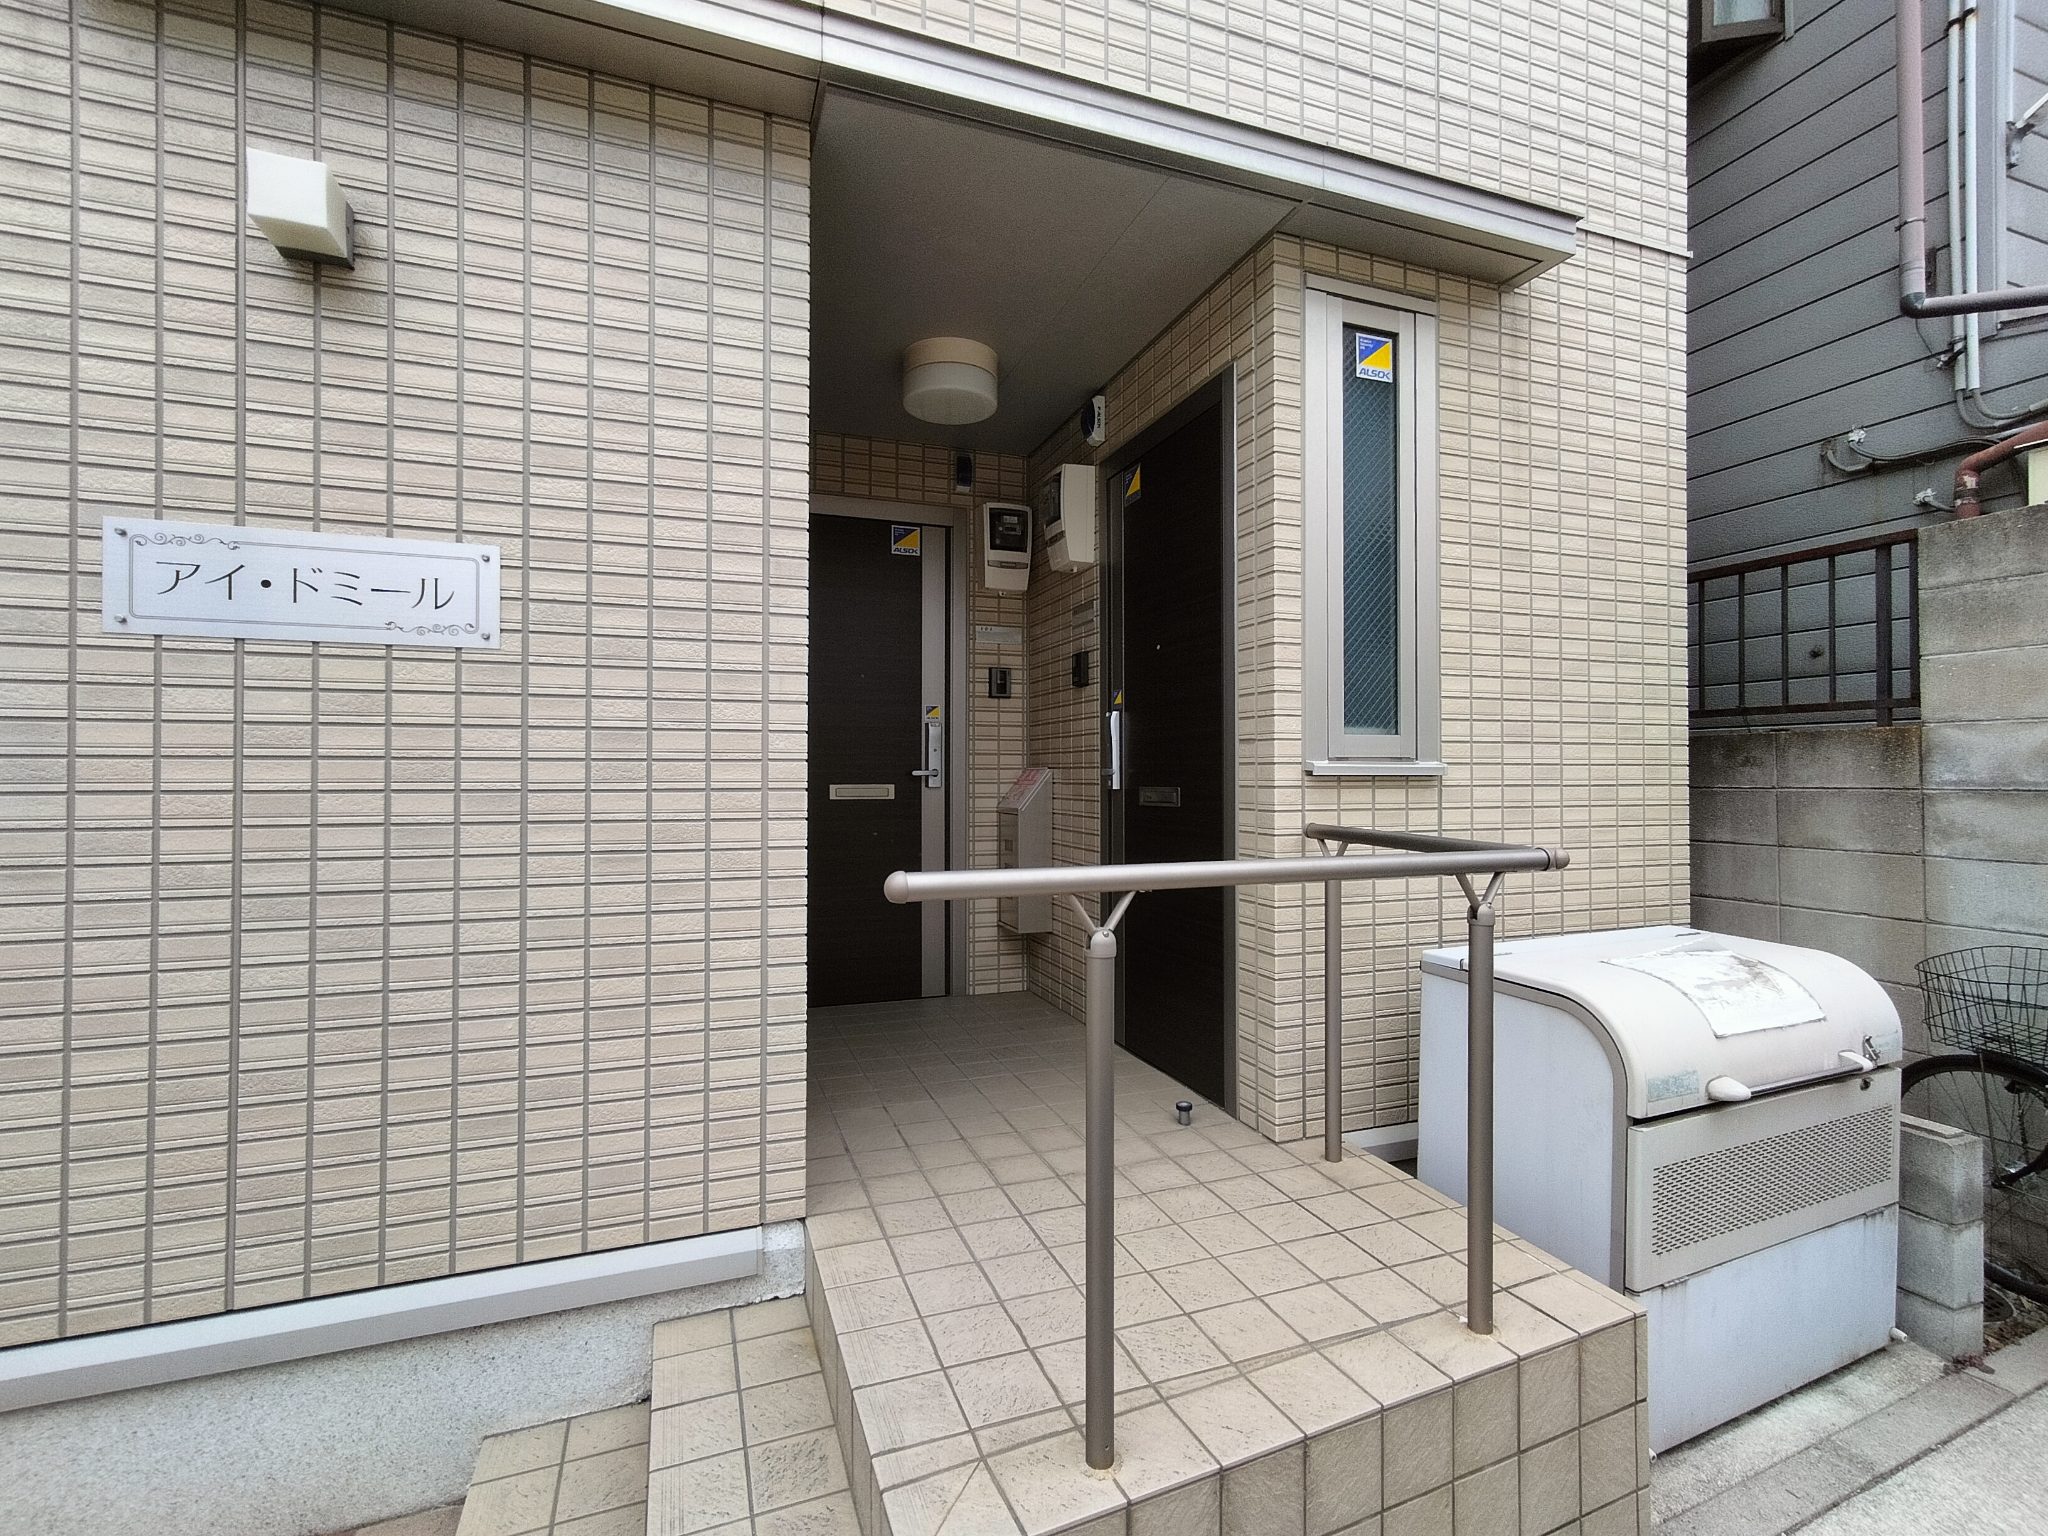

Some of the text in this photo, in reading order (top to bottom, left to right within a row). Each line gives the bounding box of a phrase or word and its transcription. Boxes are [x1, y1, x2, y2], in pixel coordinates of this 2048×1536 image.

[1359, 368, 1390, 380] ALSOK
[156, 561, 455, 610] アイ・ドミール
